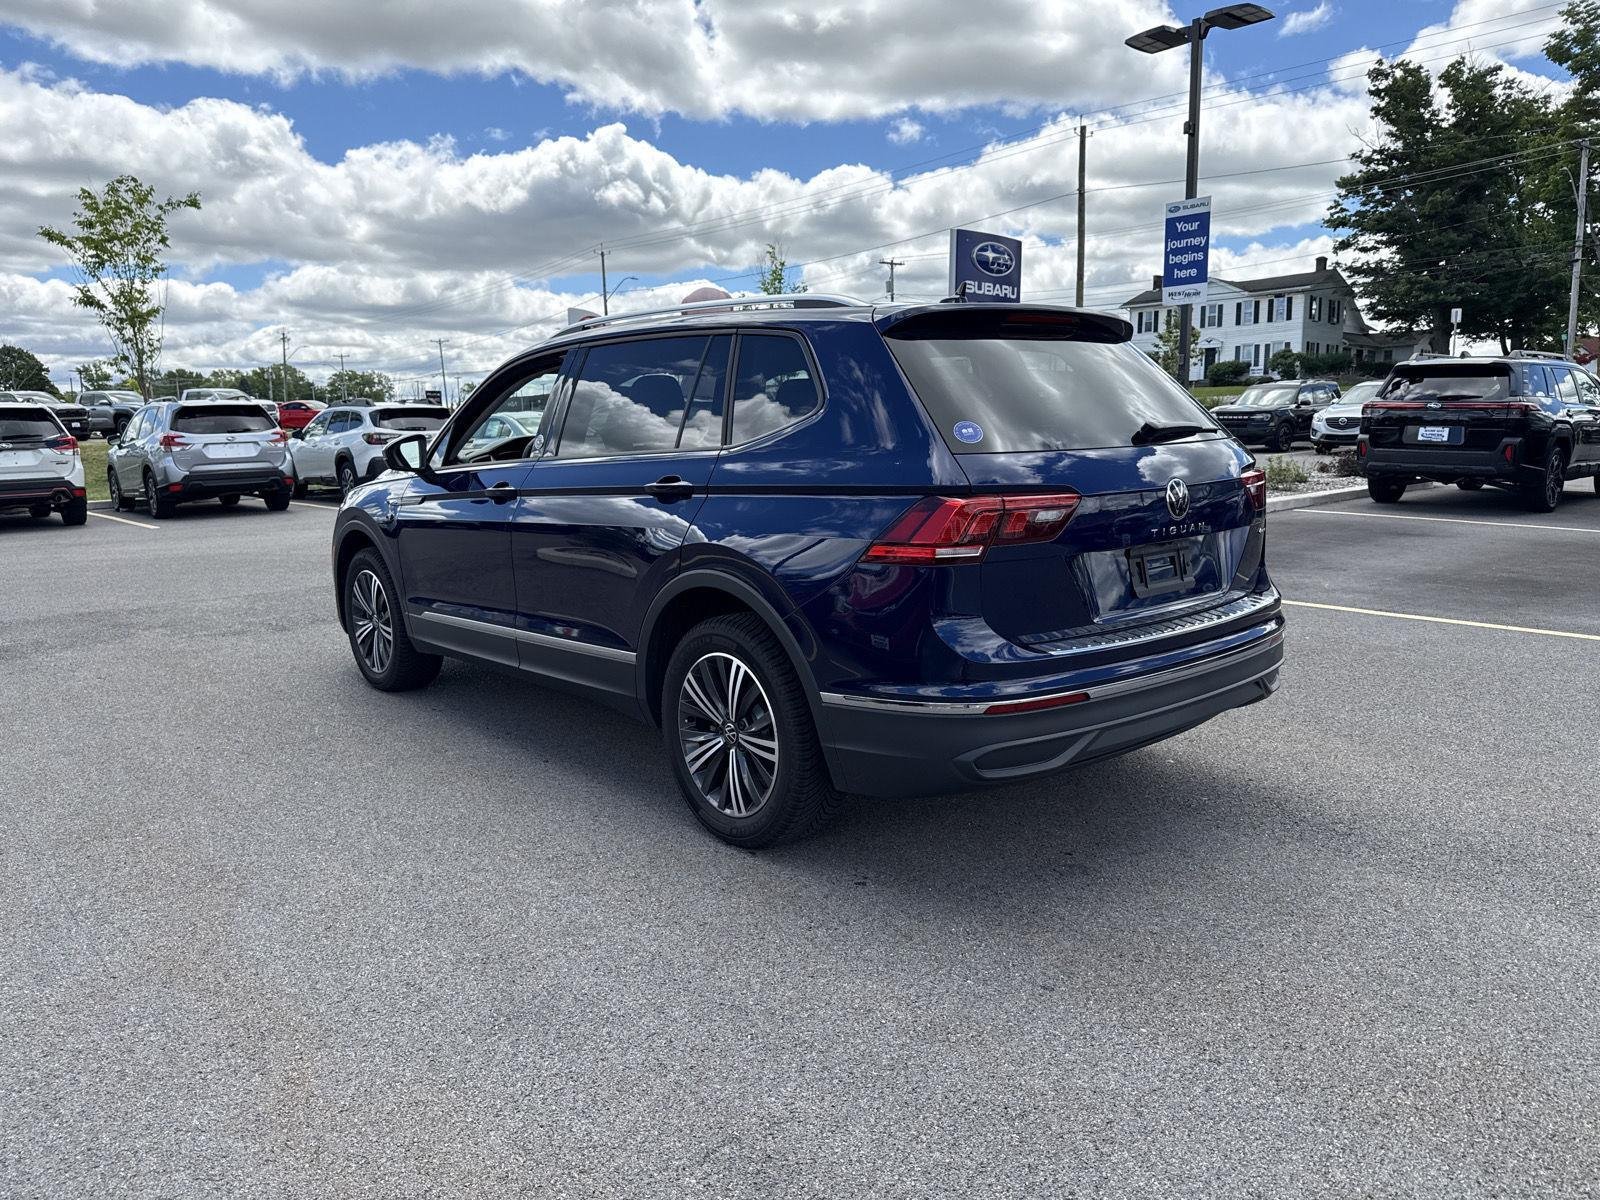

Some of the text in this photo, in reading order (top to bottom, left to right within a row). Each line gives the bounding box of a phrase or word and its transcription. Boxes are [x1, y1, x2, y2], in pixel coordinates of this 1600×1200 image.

[1182, 201, 1209, 210] SUBARU
[1176, 221, 1200, 233] Your
[1167, 236, 1207, 251] journey
[1169, 251, 1204, 265] begins
[1174, 268, 1198, 279] here
[966, 280, 1017, 298] SUBARU
[1151, 521, 1206, 537] TIGUAN
